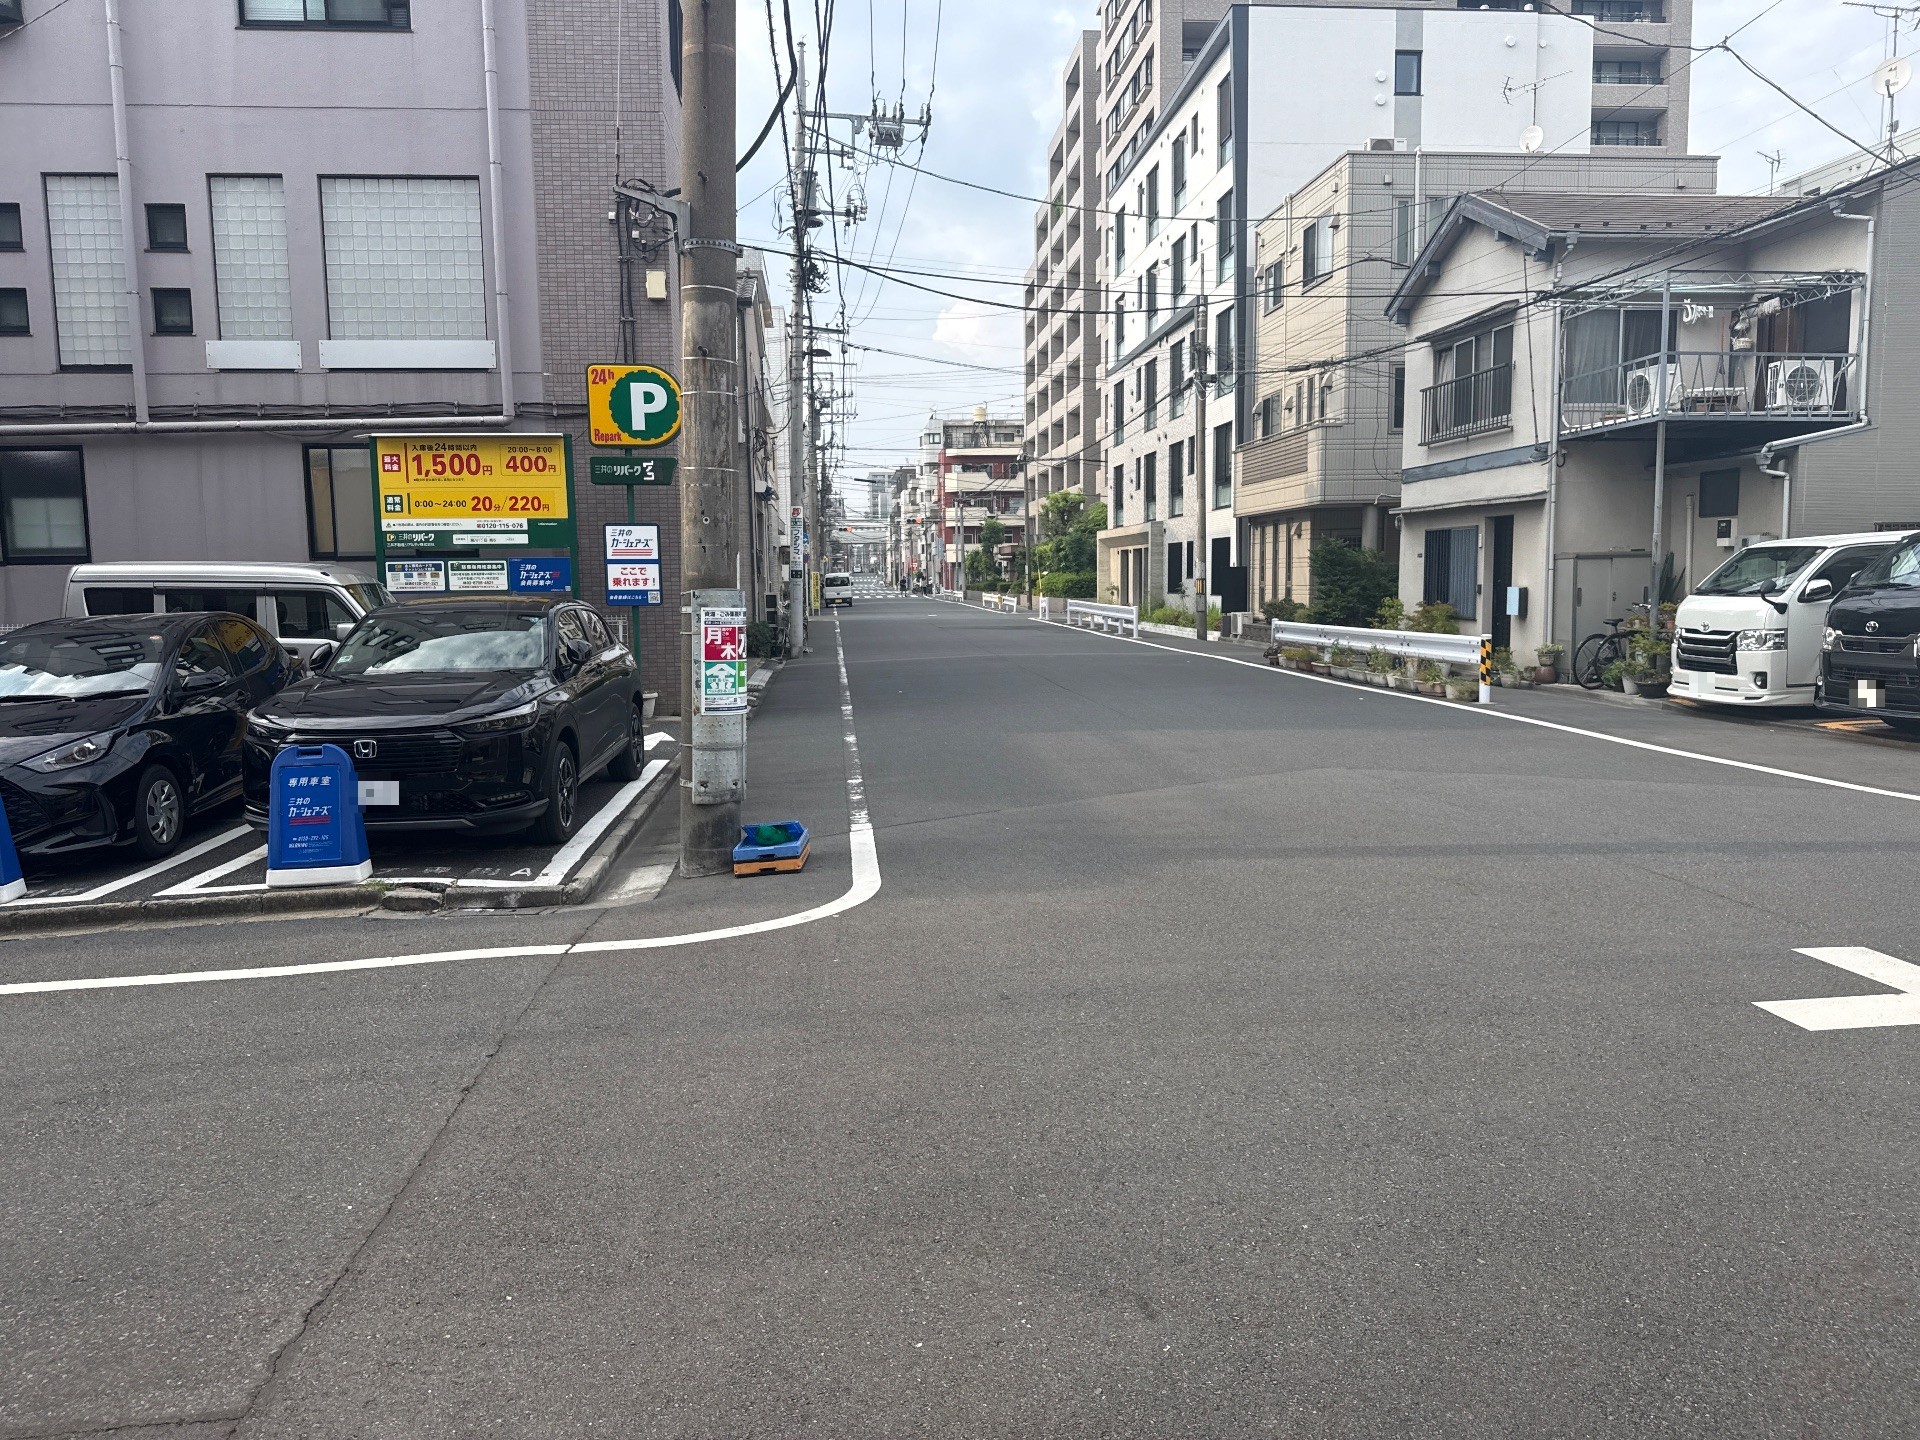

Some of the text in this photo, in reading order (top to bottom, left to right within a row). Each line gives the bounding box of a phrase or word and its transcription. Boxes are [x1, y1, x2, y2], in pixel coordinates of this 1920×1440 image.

[591, 368, 614, 385] 24h
[630, 382, 668, 431] P
[594, 428, 622, 443] Repark
[412, 443, 477, 451] 入庫後24時間以内
[412, 453, 493, 477] 1,500円
[505, 455, 556, 473] 400円
[595, 464, 642, 476] 三井のリパーク
[398, 532, 435, 542] 三井のリパーク
[611, 528, 633, 537] 三井の
[611, 537, 653, 548] カーシェアーズ
[519, 563, 537, 571] 三井の
[620, 567, 647, 576] ここで
[520, 571, 553, 579] カーシェアーズ
[705, 627, 722, 645] 月
[720, 642, 737, 660] 木
[705, 663, 737, 691] 金
[288, 776, 332, 787] 専用車室
[288, 797, 311, 806] 三井の
[288, 805, 332, 817] カーシェアーズ
